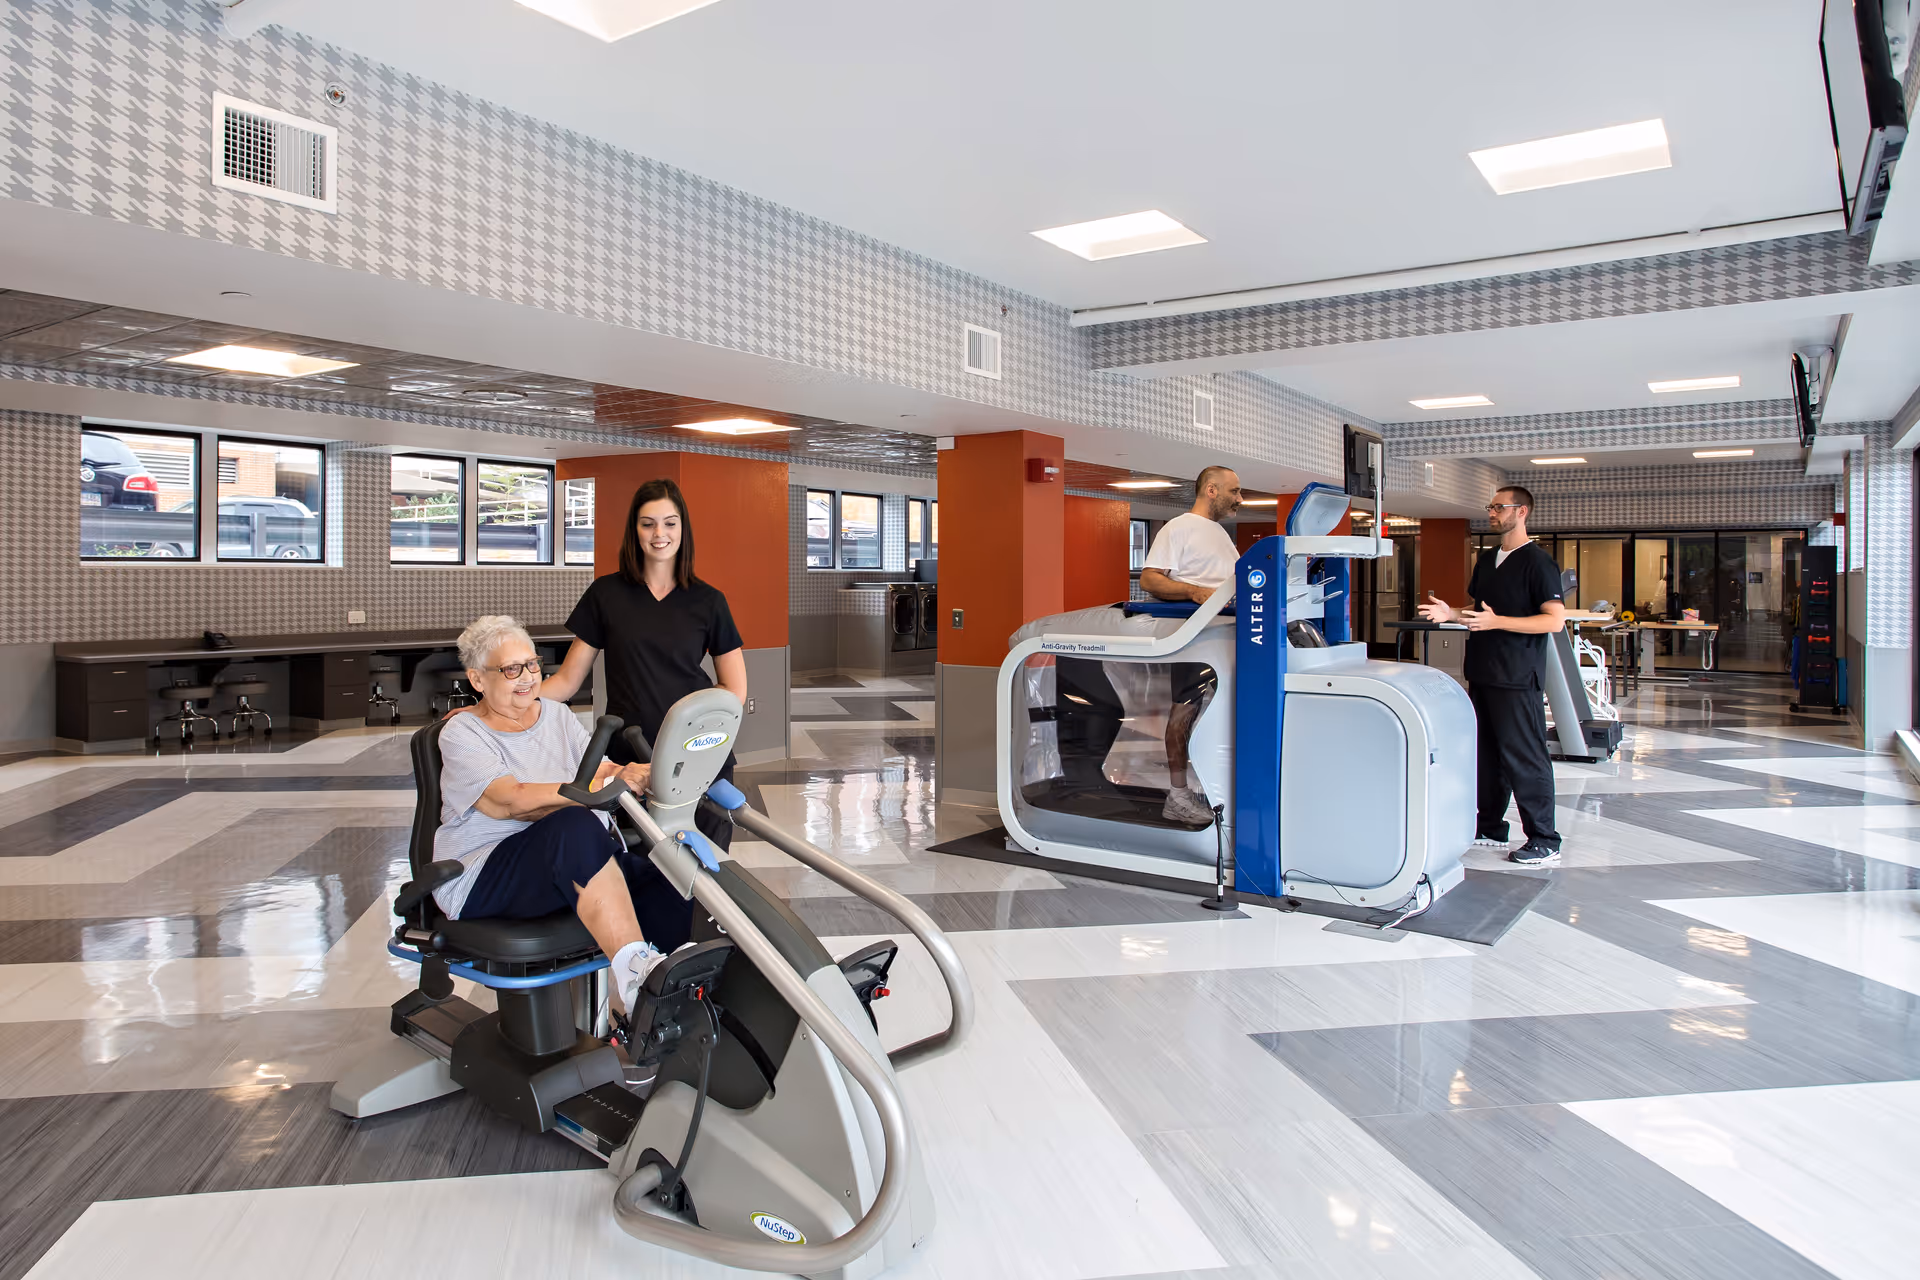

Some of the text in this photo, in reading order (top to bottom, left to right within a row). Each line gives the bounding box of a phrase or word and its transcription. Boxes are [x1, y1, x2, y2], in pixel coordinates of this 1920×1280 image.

[1041, 642, 1106, 652] Anti-Gravity Treadmill
[691, 735, 721, 746] NuStep
[760, 1216, 795, 1240] NuStep
